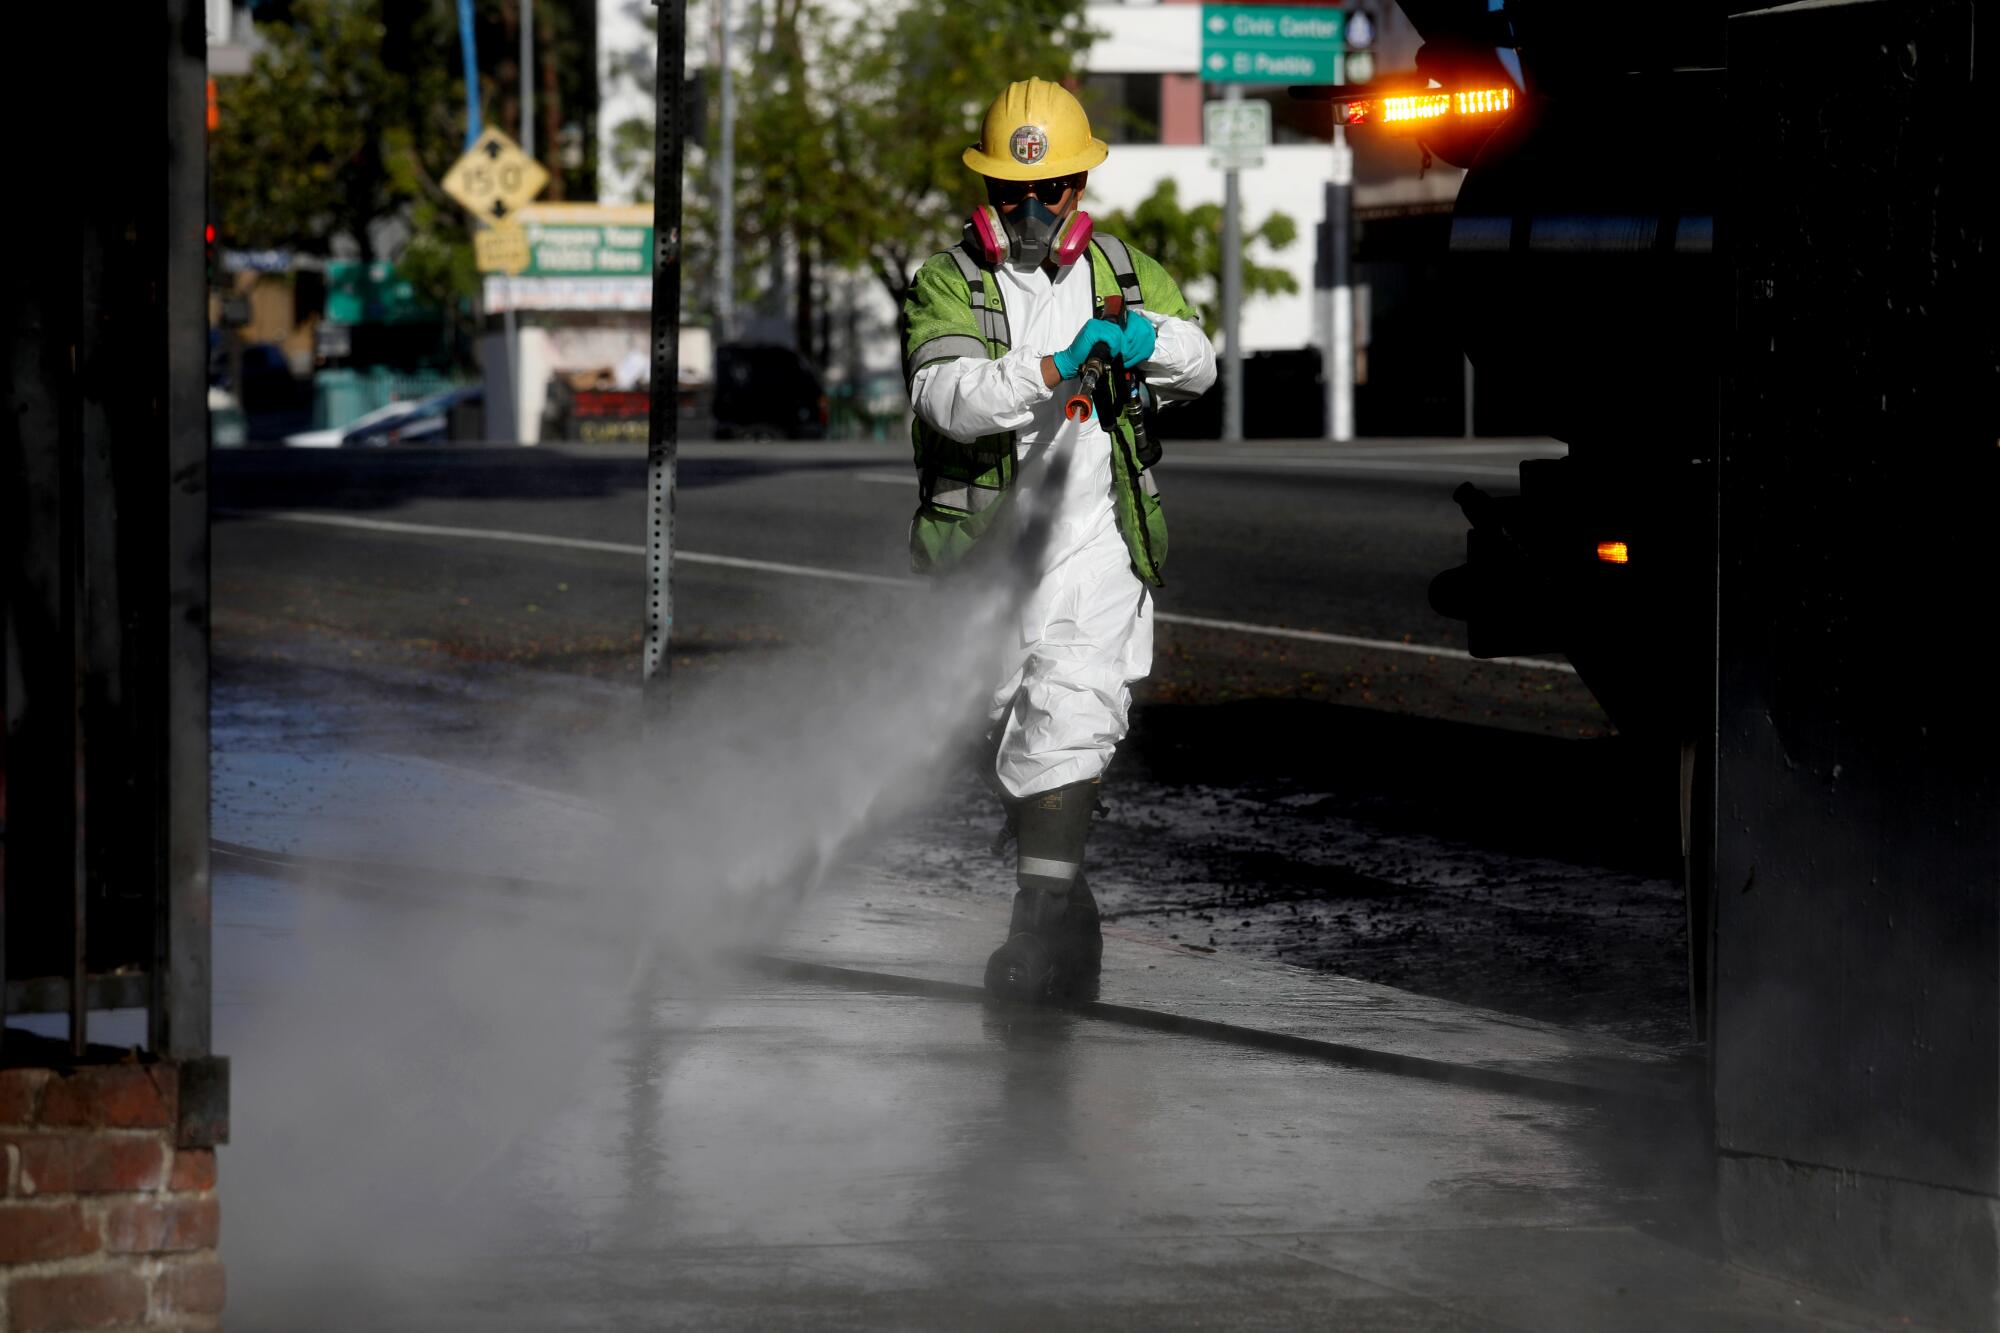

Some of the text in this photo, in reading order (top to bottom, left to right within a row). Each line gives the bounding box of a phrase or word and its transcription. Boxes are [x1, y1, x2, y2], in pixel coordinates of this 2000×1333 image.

[1233, 15, 1338, 39] Civic Center
[1233, 52, 1315, 76] El Pueblo
